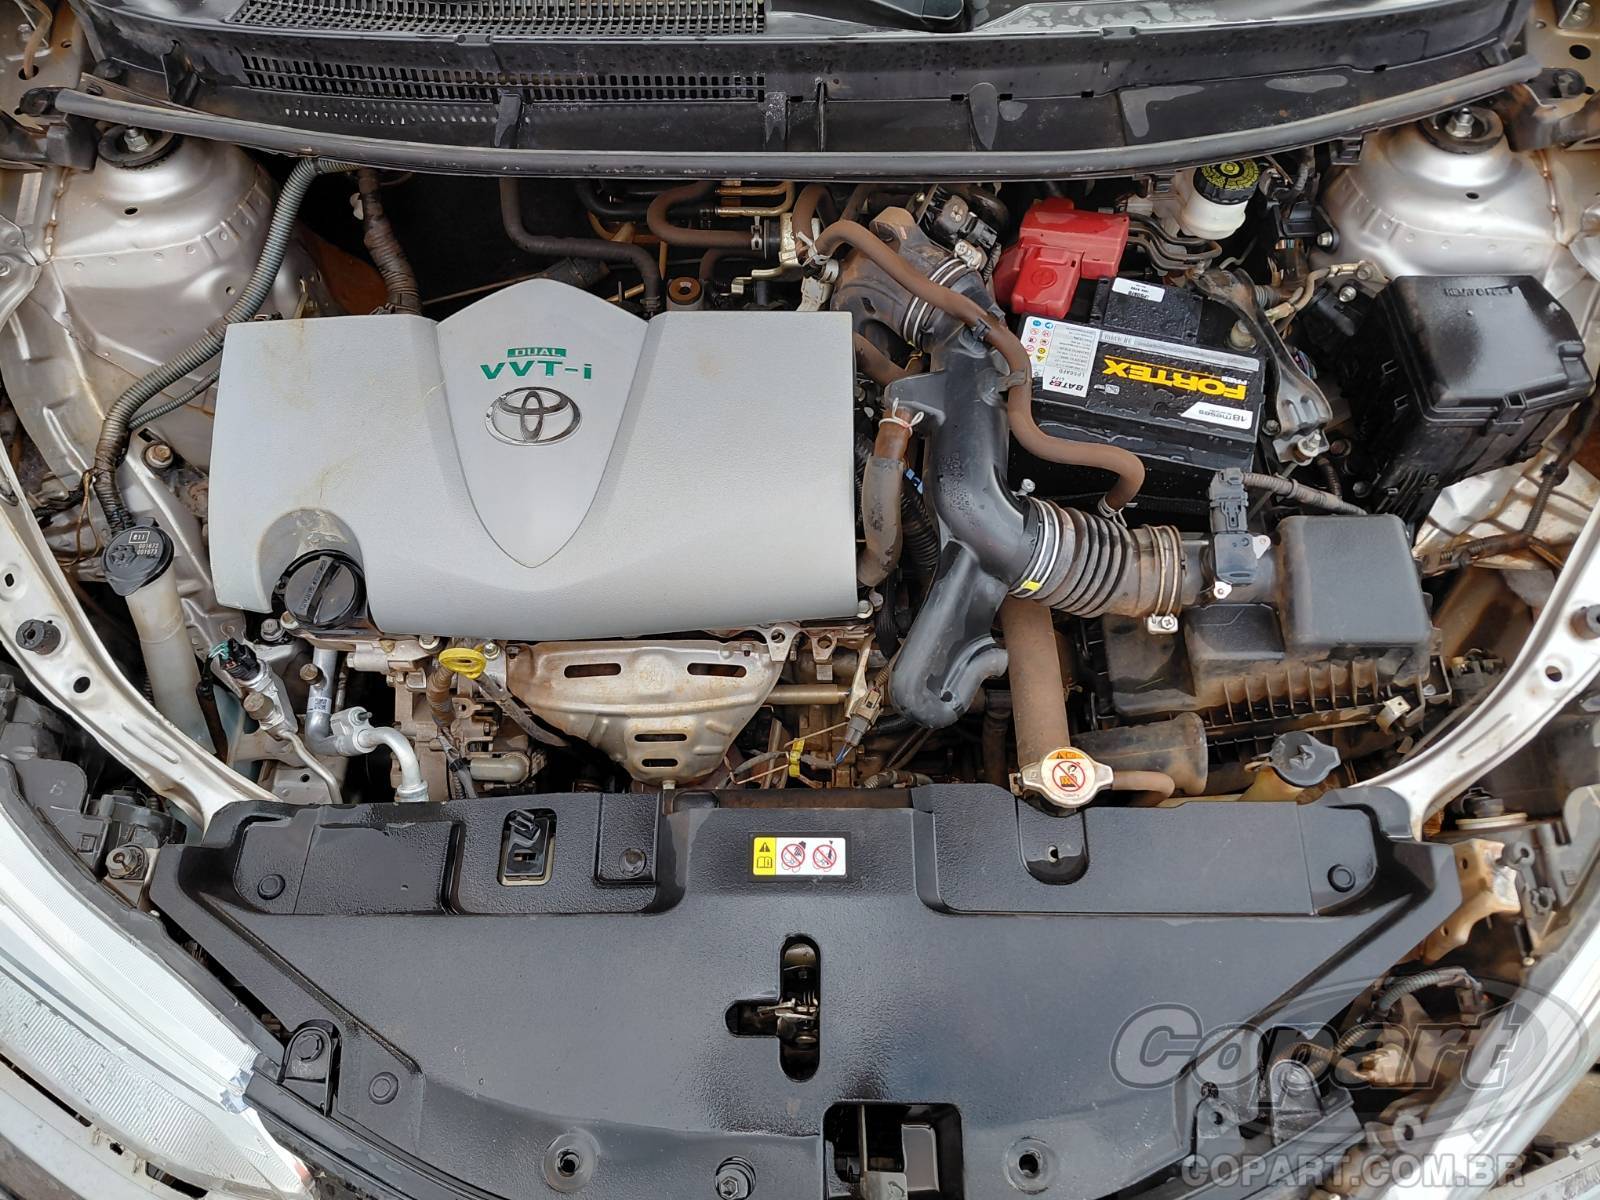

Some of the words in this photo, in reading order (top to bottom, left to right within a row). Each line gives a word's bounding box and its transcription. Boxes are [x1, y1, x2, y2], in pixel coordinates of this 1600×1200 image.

[515, 348, 560, 357] DUAL
[480, 360, 592, 380] VVT-i
[1102, 358, 1247, 401] FORTEX
[1049, 380, 1084, 392] BATER
[1198, 409, 1232, 420] meses
[1232, 413, 1247, 423] 18
